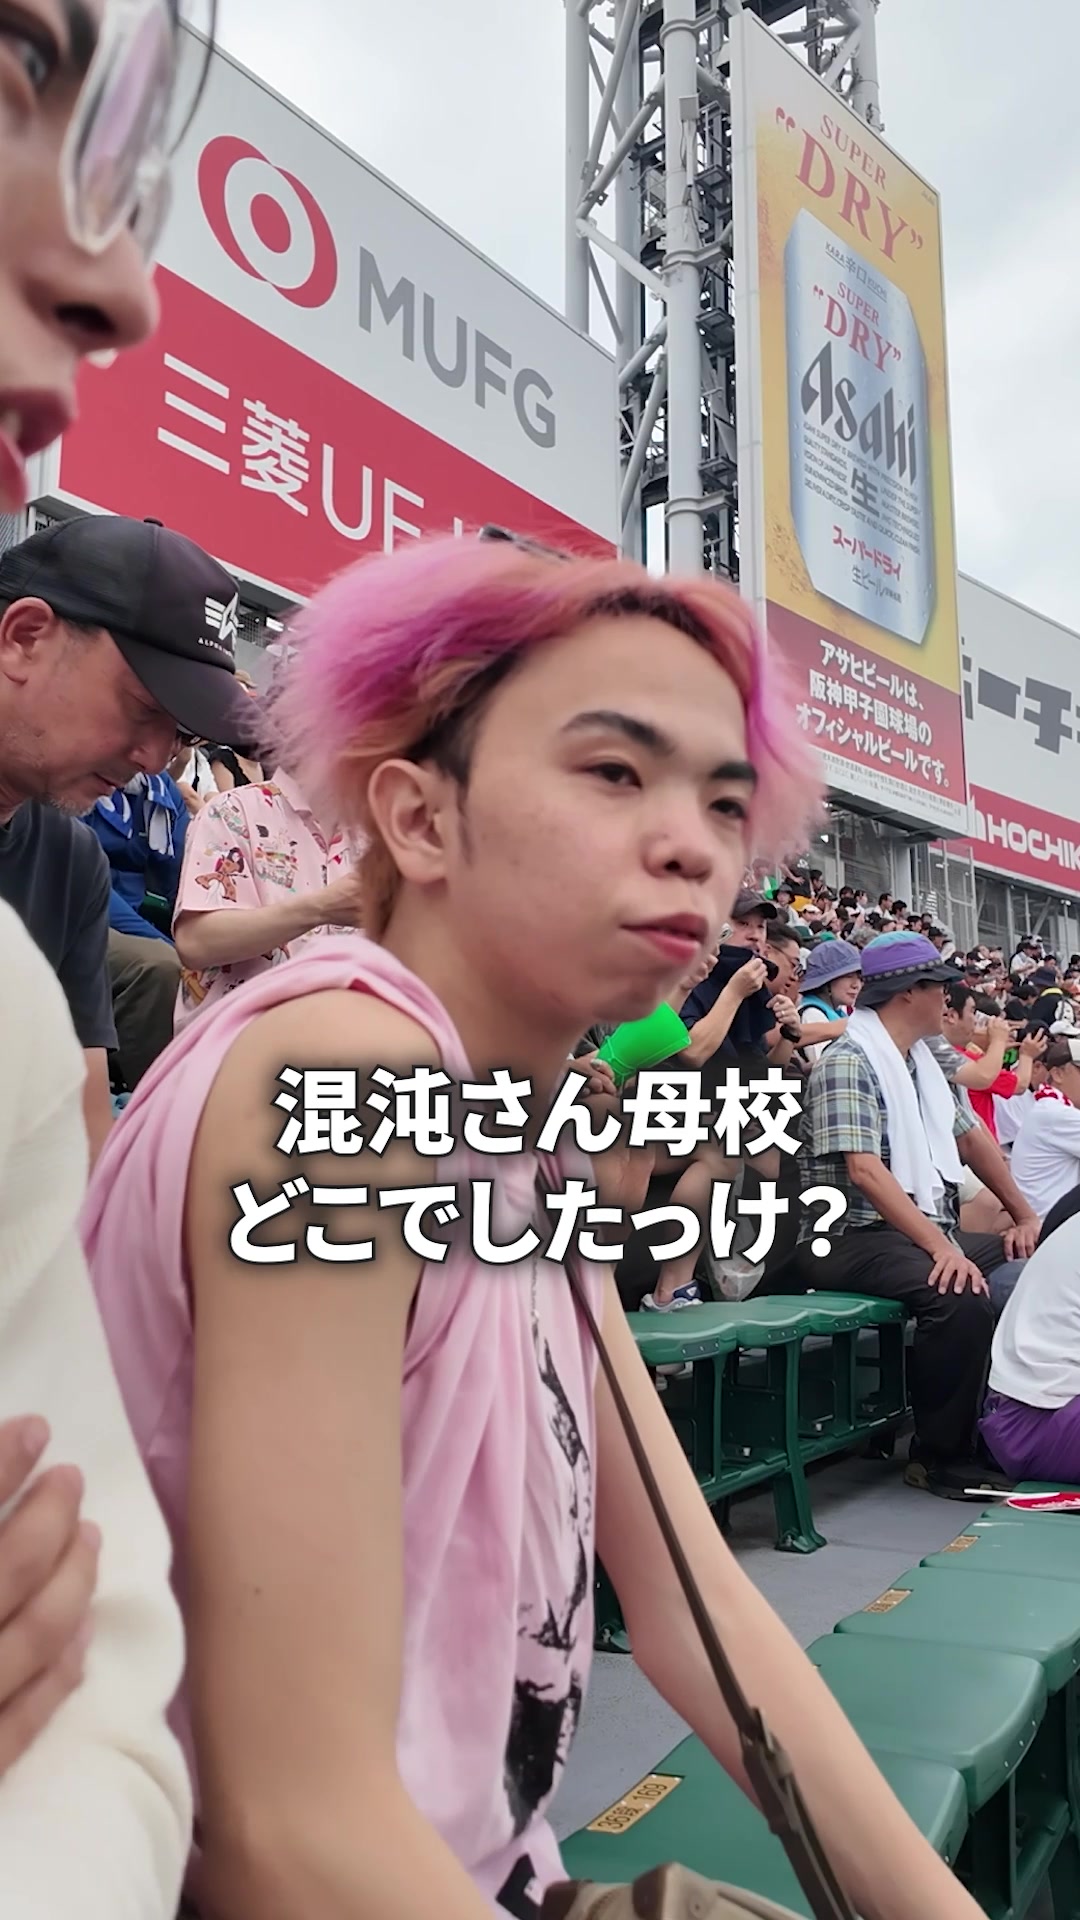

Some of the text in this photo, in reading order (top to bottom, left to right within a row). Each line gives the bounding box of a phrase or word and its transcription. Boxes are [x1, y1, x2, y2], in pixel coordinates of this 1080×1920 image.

[820, 114, 887, 191] SUPER
[837, 281, 880, 327] SUPER
[358, 245, 556, 449] MUFG
[801, 340, 917, 485] Asahi
[851, 467, 880, 518] 生
[833, 525, 901, 581] スーパードライ
[809, 668, 932, 746] 阪神甲子園球場の
[820, 639, 924, 711] アサヒビールは、
[633, 1783, 667, 1800] 169
